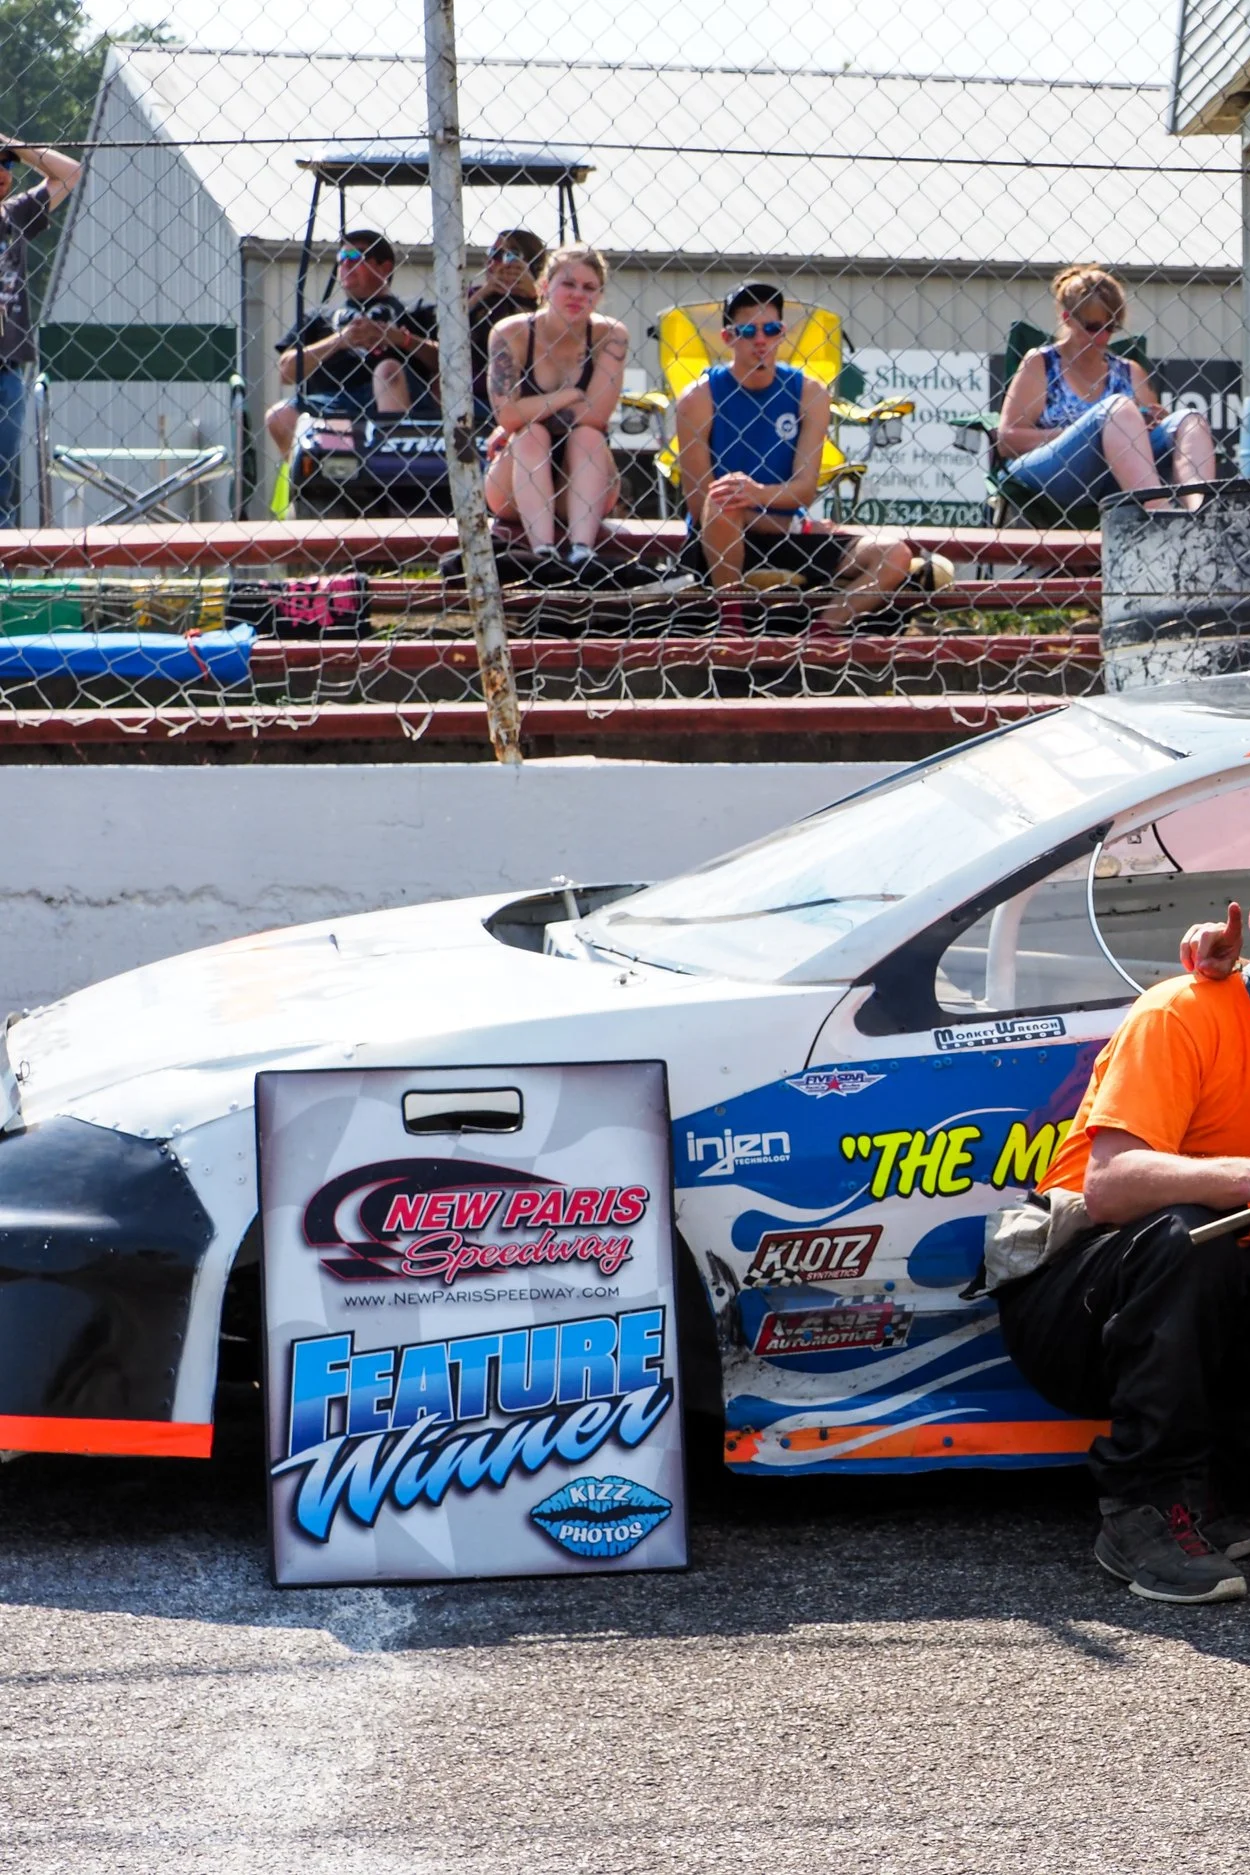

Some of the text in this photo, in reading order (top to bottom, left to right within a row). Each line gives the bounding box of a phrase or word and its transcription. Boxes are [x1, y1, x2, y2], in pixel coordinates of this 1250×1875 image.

[875, 365, 983, 392] Sherlock
[734, 1155, 791, 1165] TECHNOLOGY
[382, 1185, 650, 1233] NEW PARIS
[402, 1229, 632, 1284] Speedway
[760, 1234, 873, 1272] KLOTZ
[806, 1267, 861, 1282] SYNTHETICS
[287, 1306, 667, 1458] FEATURE
[270, 1378, 674, 1543] Winner
[570, 1483, 630, 1504] KIZZ
[559, 1520, 644, 1544] PHOTOS
